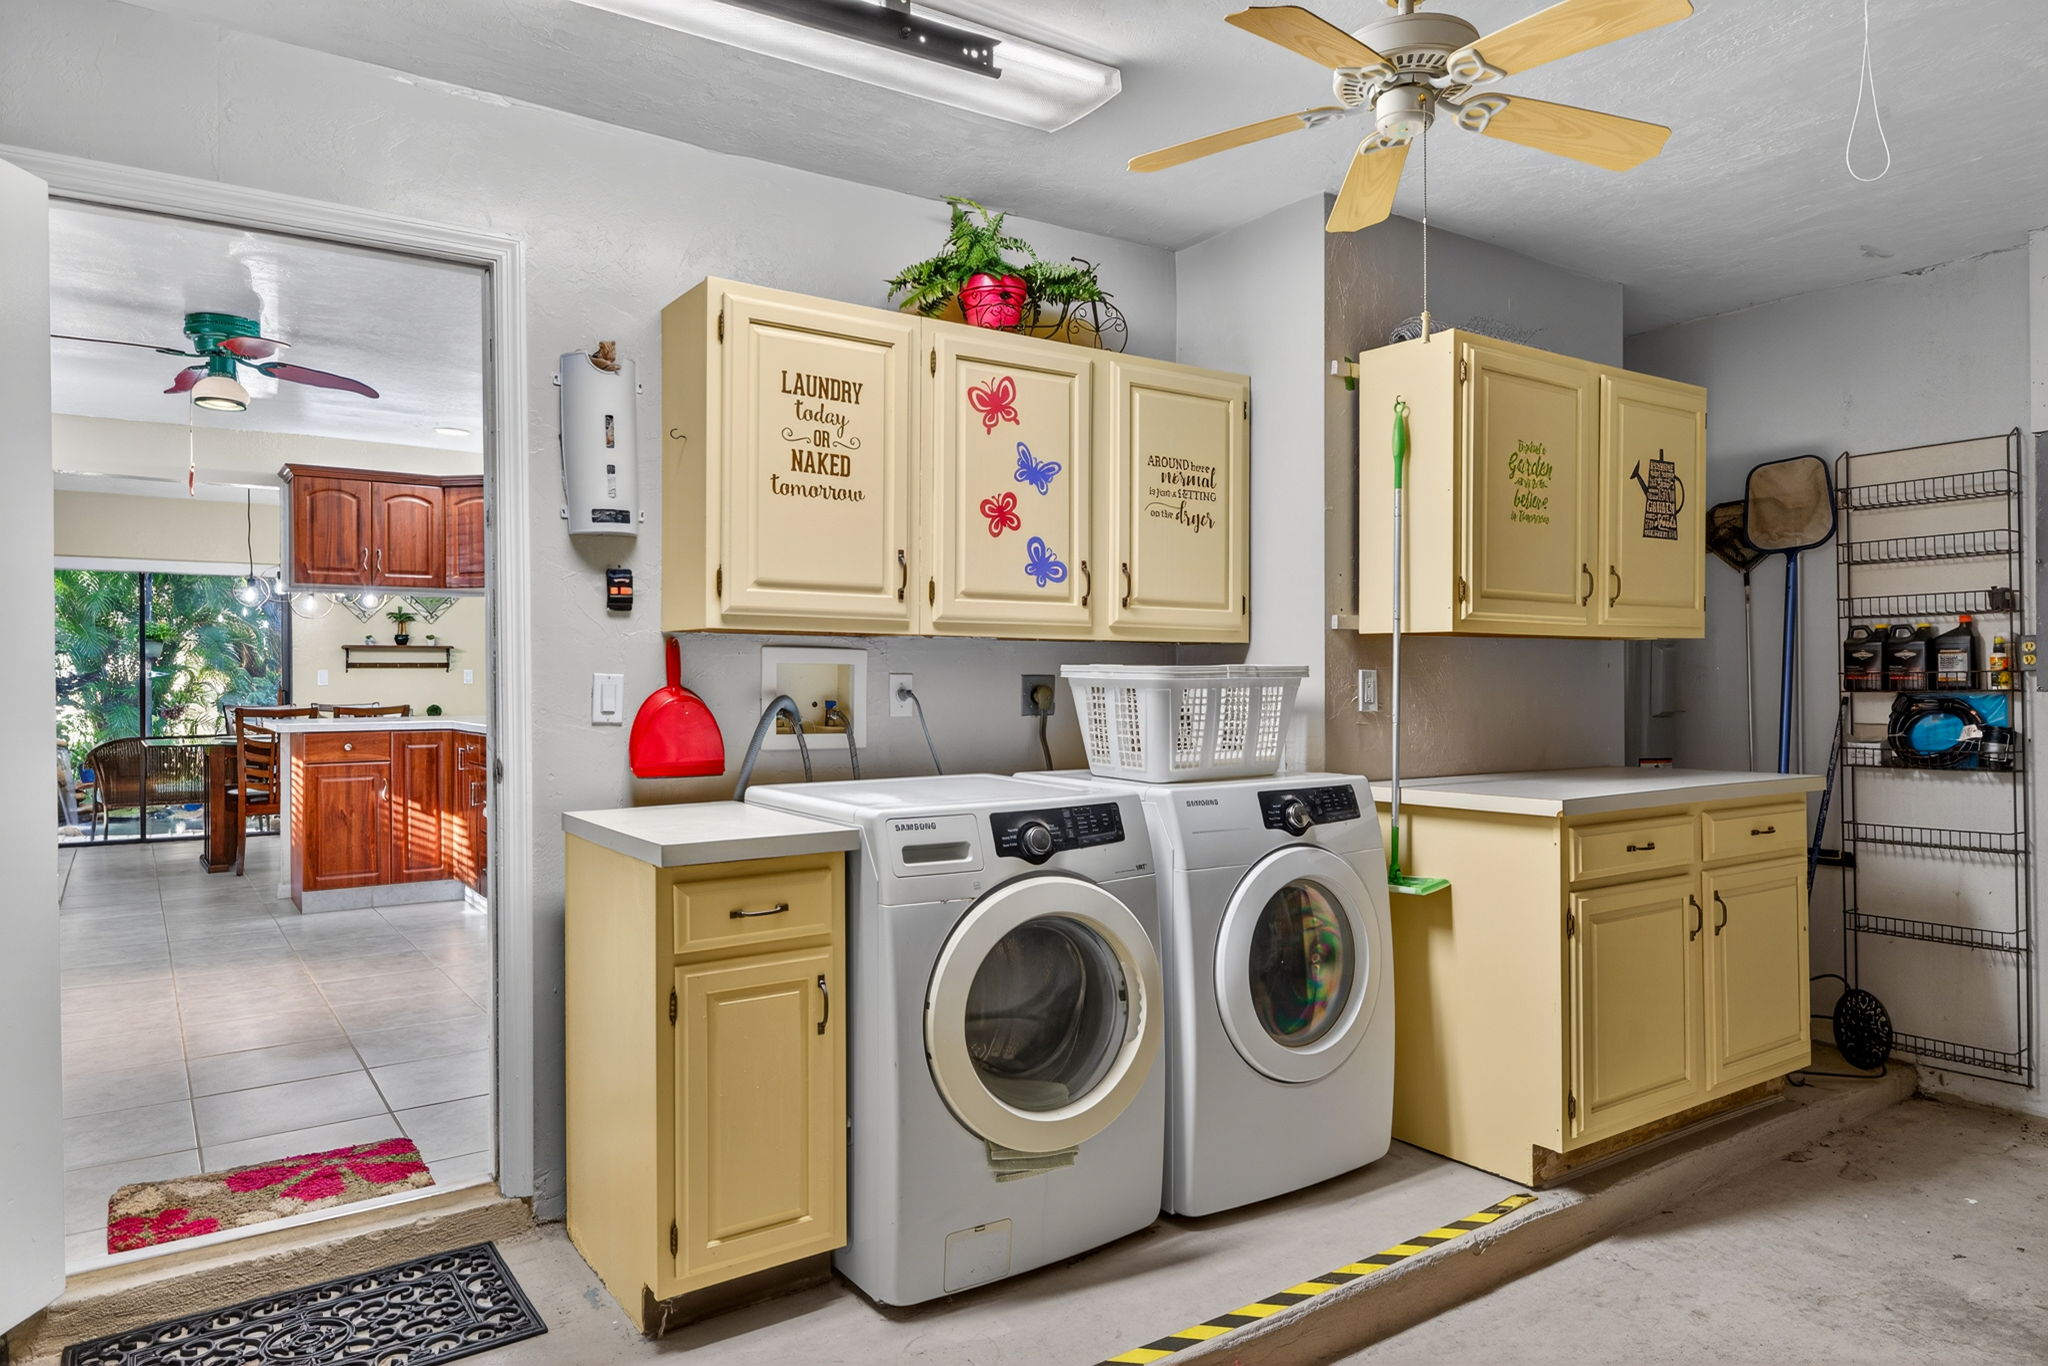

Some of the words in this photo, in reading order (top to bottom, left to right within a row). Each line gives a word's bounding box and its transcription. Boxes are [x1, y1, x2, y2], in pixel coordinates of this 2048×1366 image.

[781, 370, 863, 405] LAUNDRY
[794, 399, 850, 439] today
[813, 429, 831, 448] OR
[790, 448, 851, 478] NAKED
[1147, 455, 1190, 471] AROUND
[770, 473, 866, 502] tomorrow
[1160, 467, 1217, 489] normal
[1175, 500, 1216, 534] dryer
[895, 822, 937, 832] SAMSUNG
